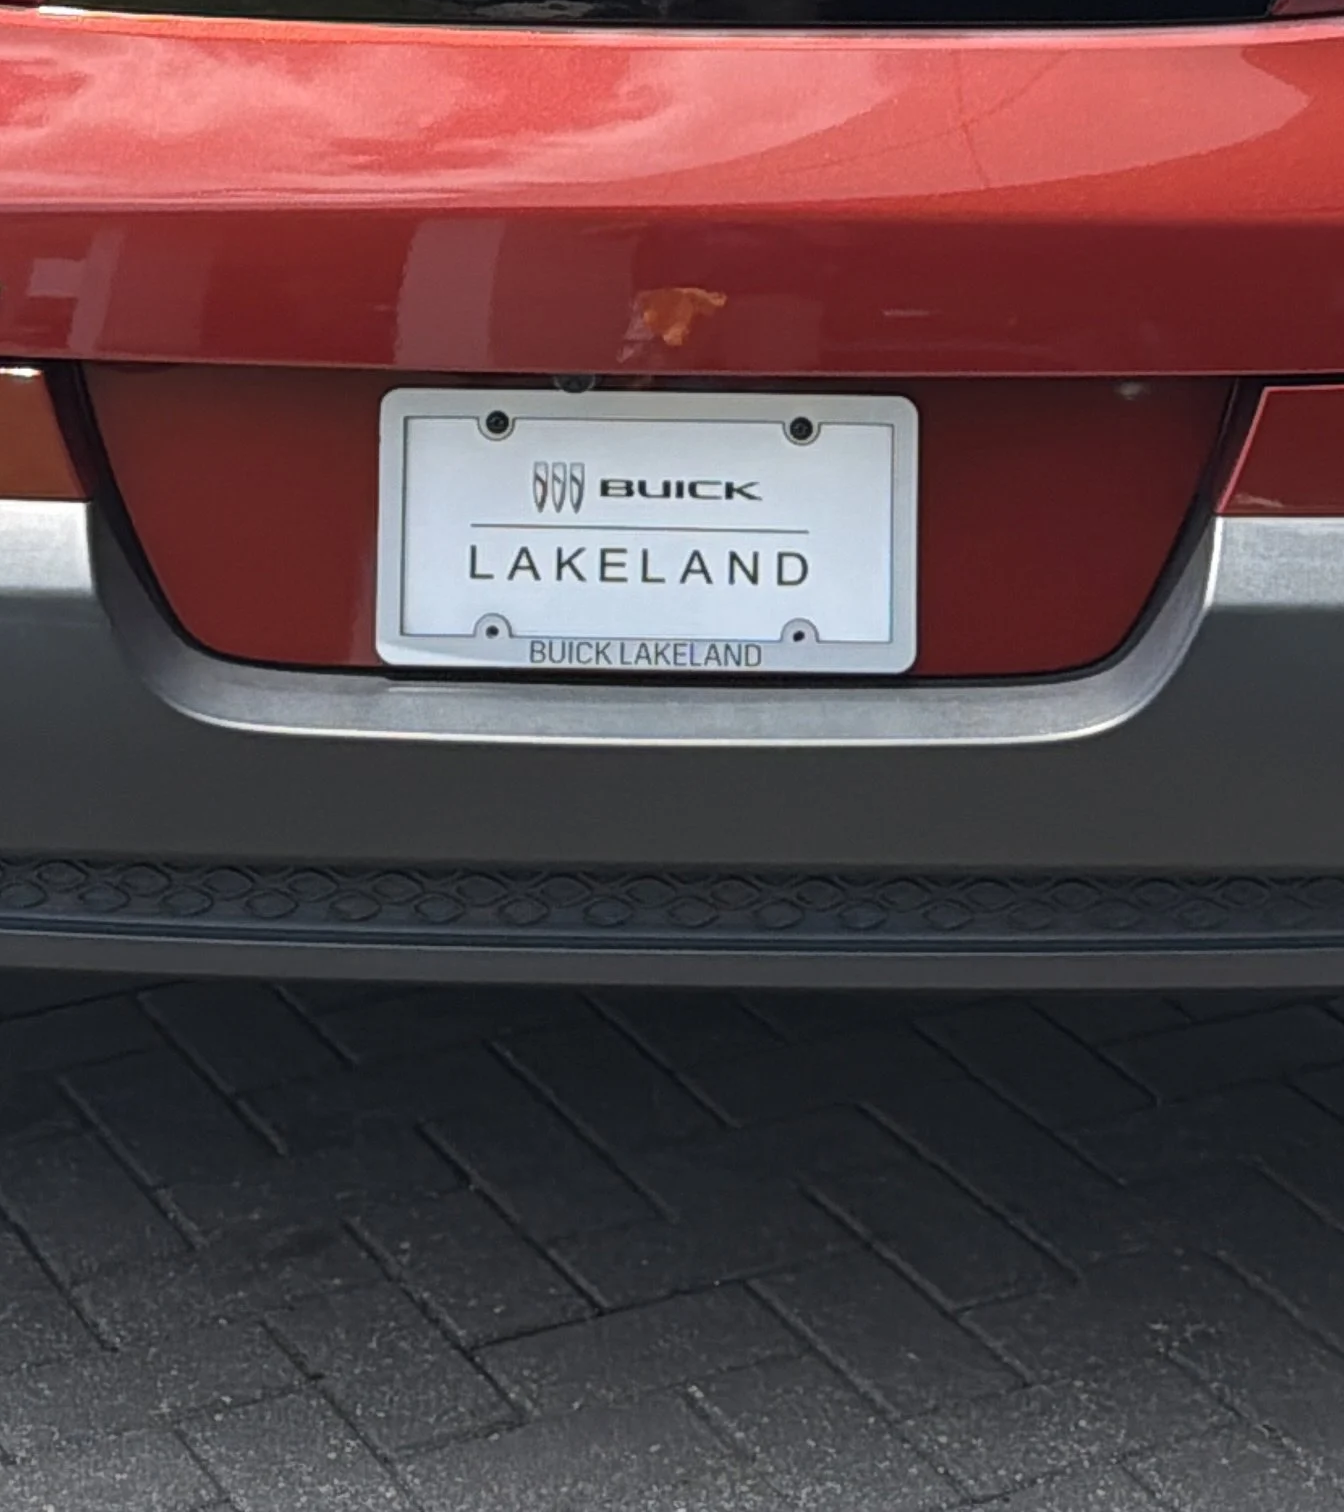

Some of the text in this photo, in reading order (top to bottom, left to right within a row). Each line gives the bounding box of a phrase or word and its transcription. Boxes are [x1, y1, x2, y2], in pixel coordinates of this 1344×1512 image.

[598, 478, 763, 502] BUICK
[468, 544, 810, 586] LAKELAND
[529, 641, 763, 668] BUICK LAKELAND
